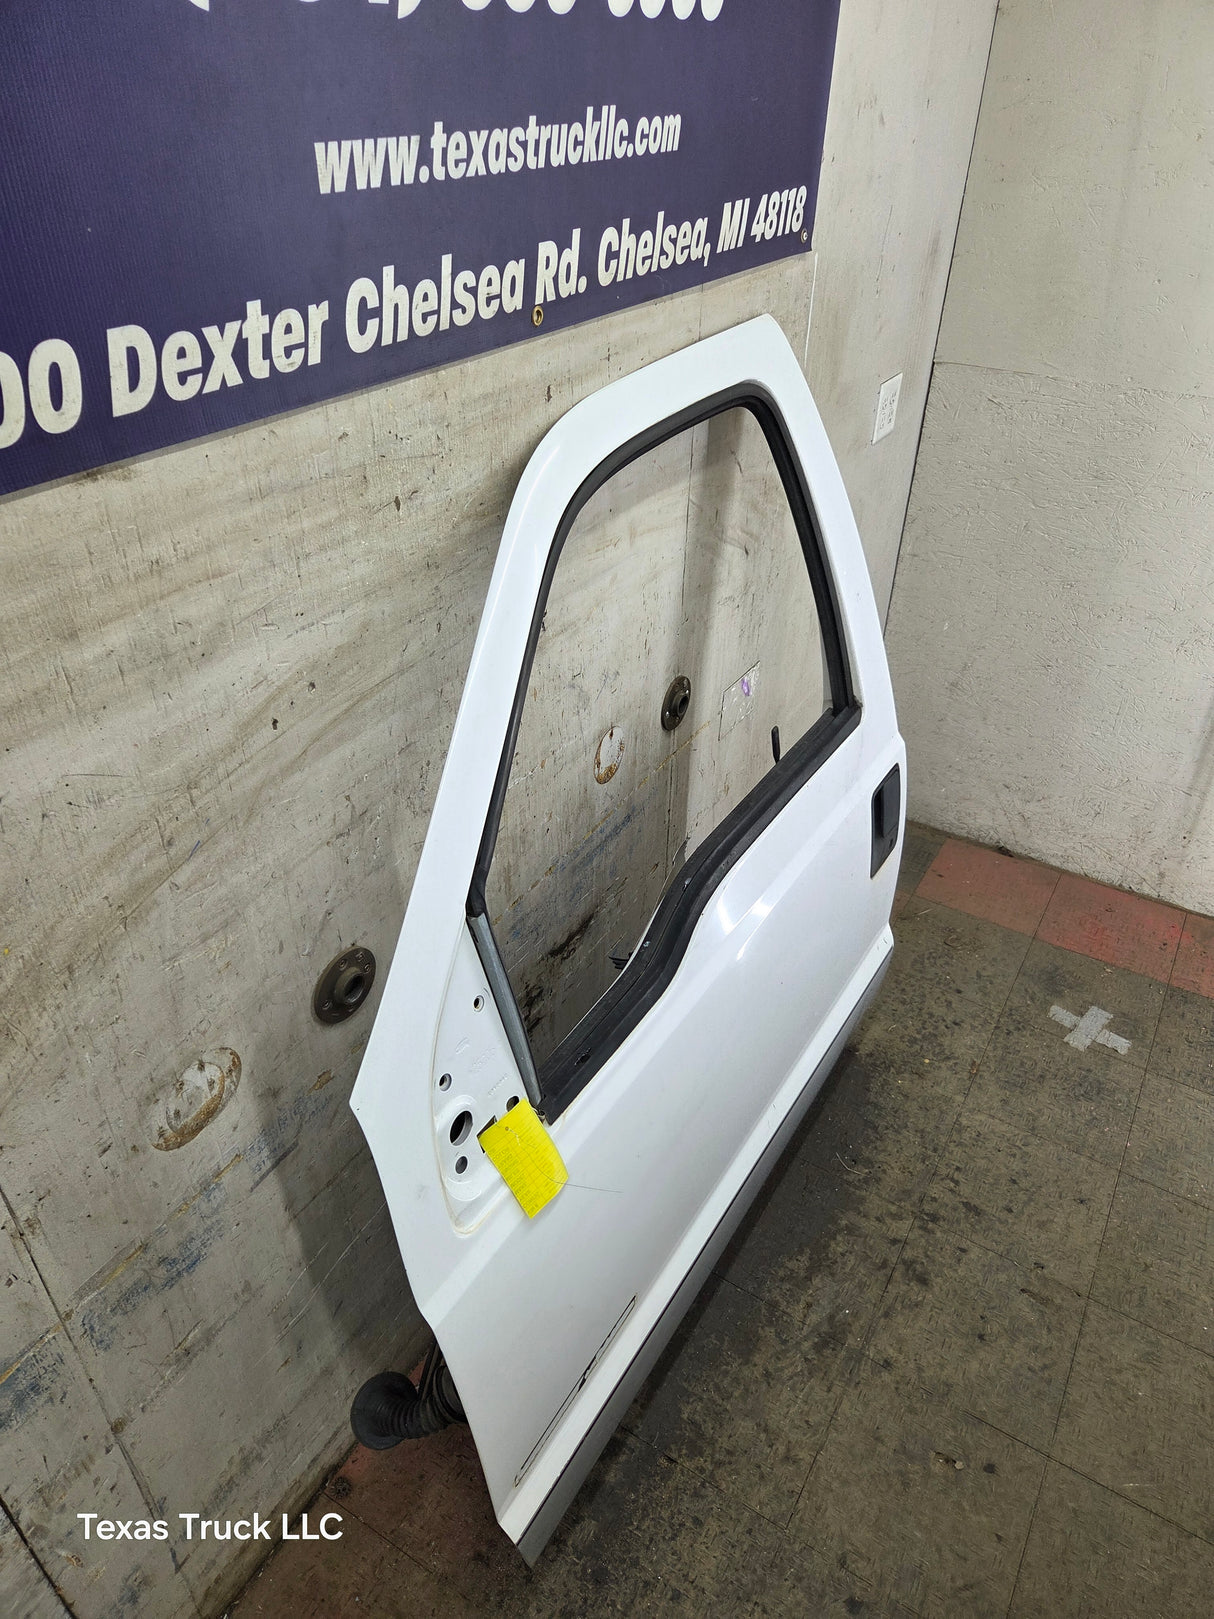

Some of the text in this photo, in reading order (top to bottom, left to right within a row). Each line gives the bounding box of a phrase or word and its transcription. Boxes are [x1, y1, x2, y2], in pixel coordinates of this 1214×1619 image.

[314, 104, 682, 195] www.texastruckllc.com
[106, 299, 329, 418] Dexter
[345, 253, 526, 354] Chelsea
[534, 228, 588, 306] Rd.
[597, 210, 711, 288] Chelsea,
[716, 197, 751, 255] MI
[750, 185, 808, 244] 48118
